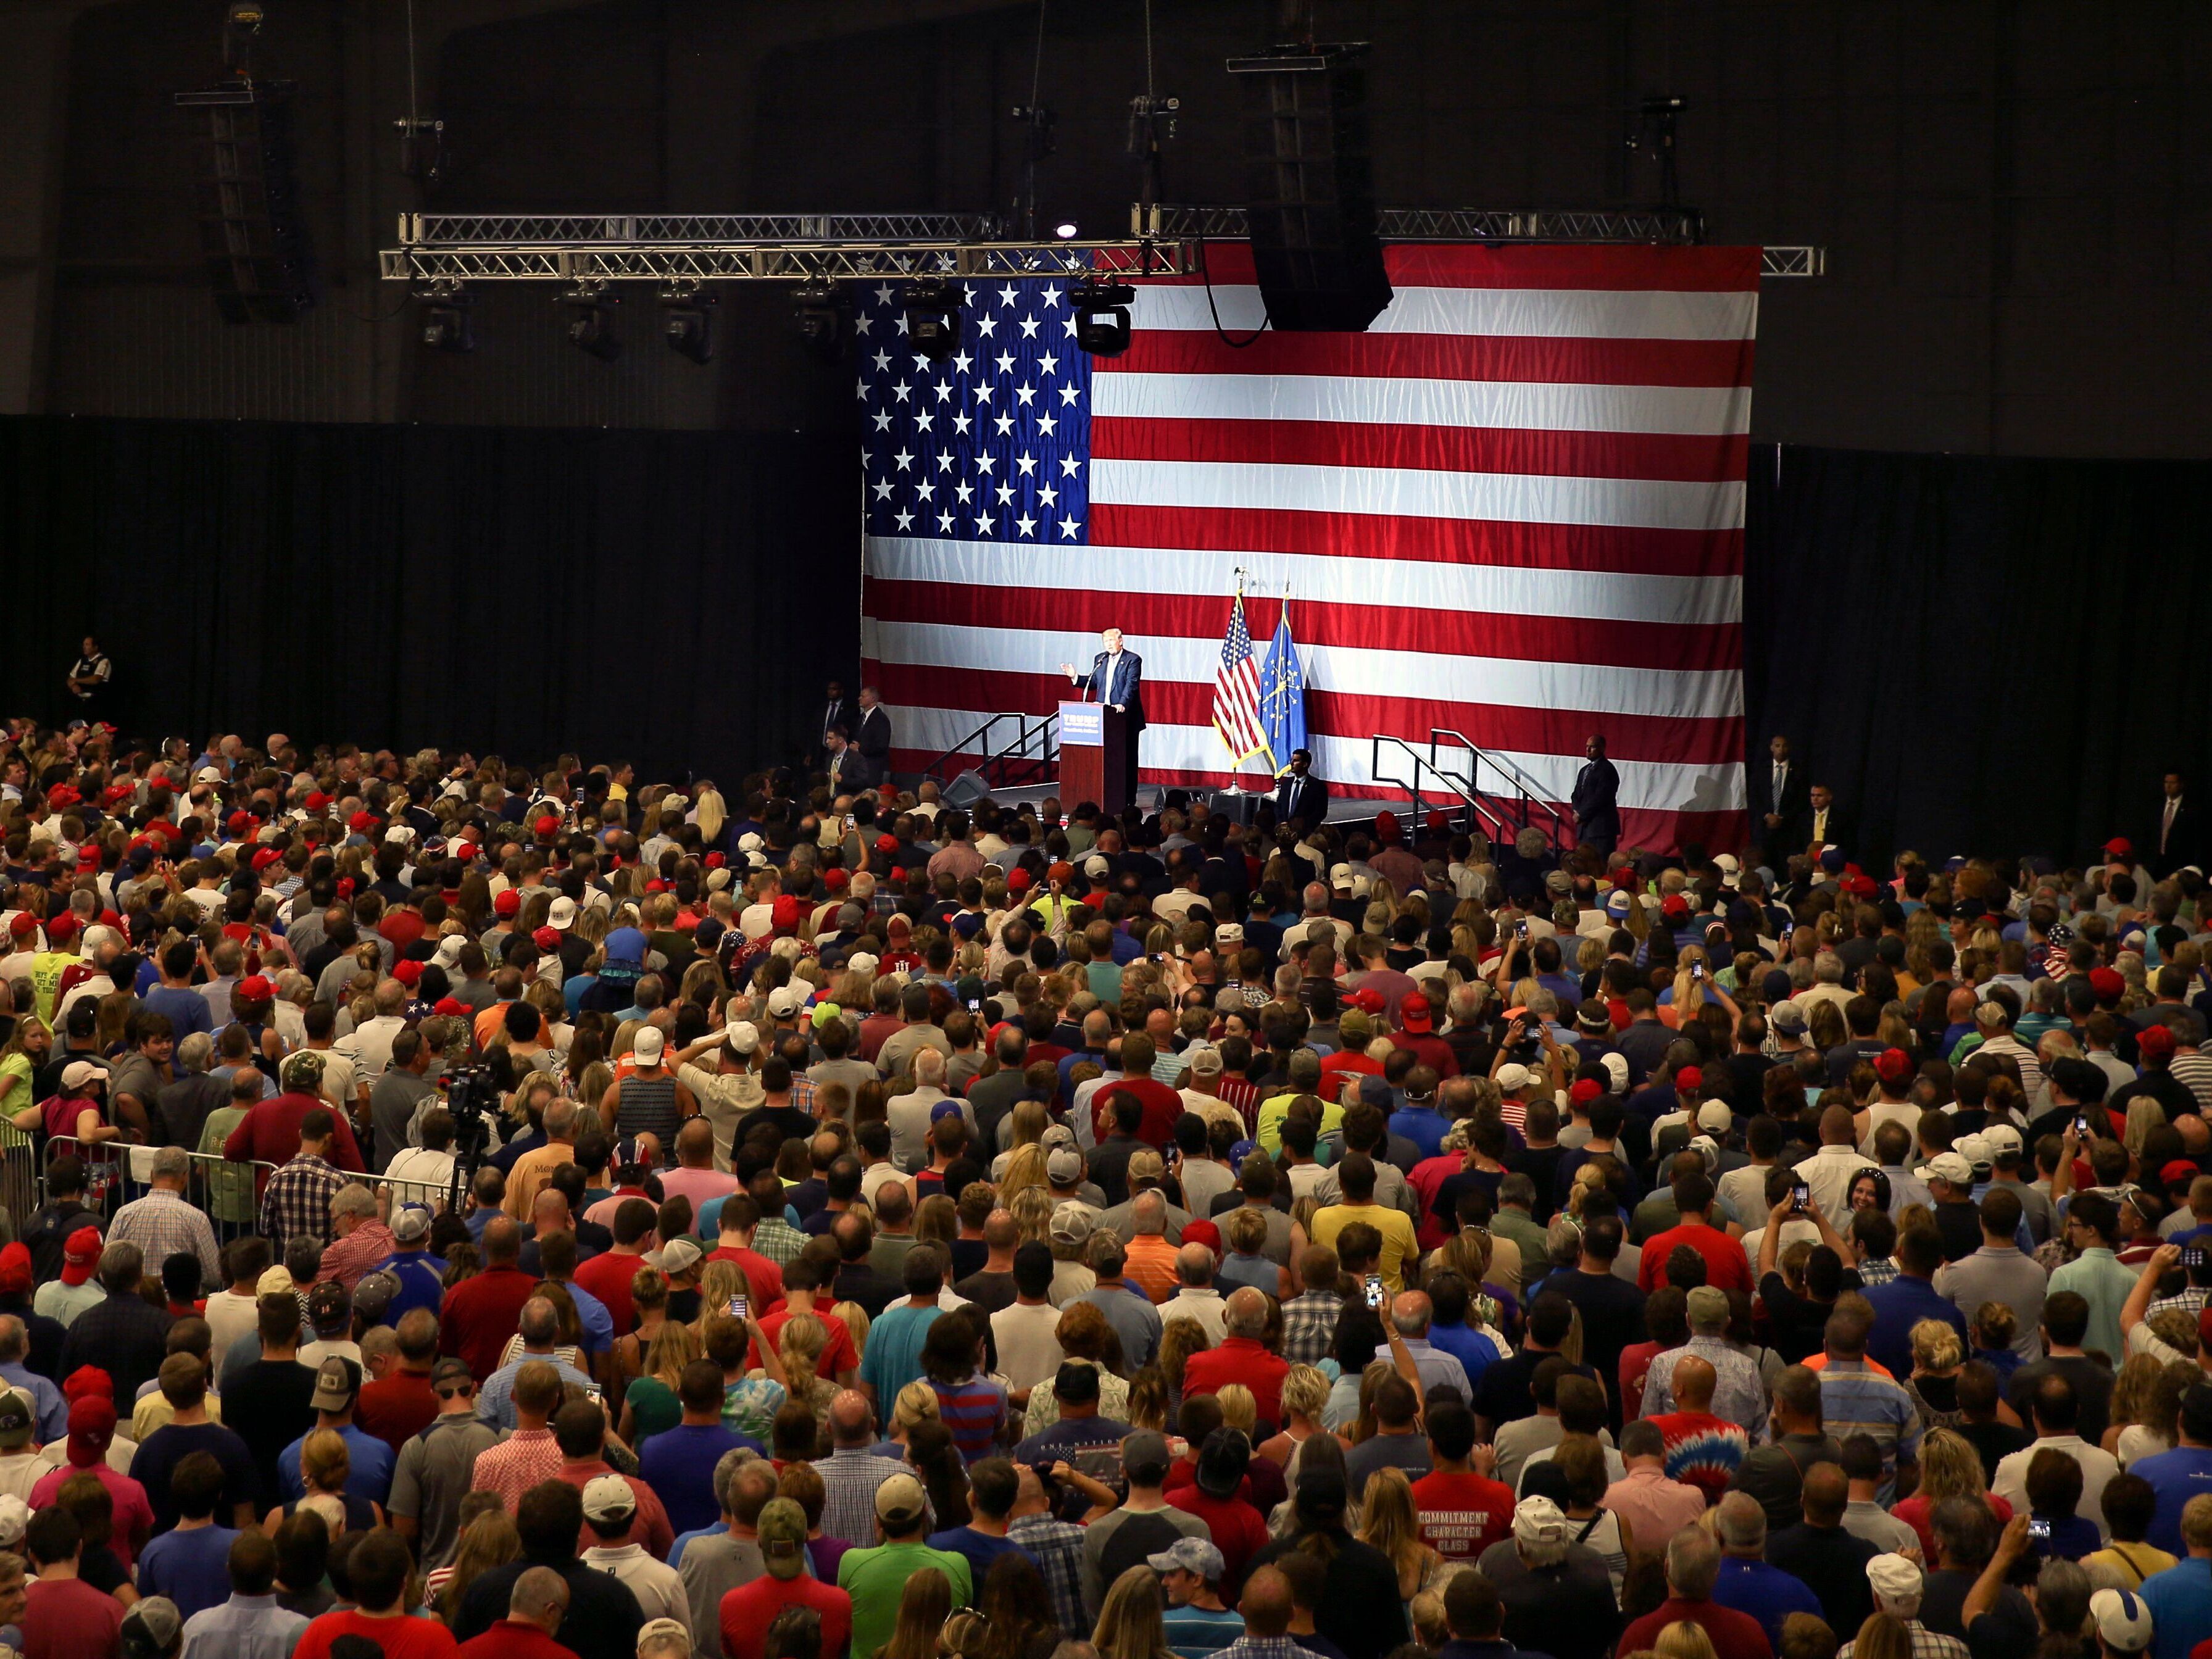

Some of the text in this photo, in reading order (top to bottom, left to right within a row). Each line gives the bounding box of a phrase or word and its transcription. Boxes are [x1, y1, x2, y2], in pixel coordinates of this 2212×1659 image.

[1063, 714, 1099, 723] TRUMP
[1041, 1443, 1062, 1451] ONE
[1418, 1511, 1489, 1524] COMMITMENT
[1425, 1525, 1482, 1538] CHARACTER
[1437, 1539, 1469, 1552] CLASS
